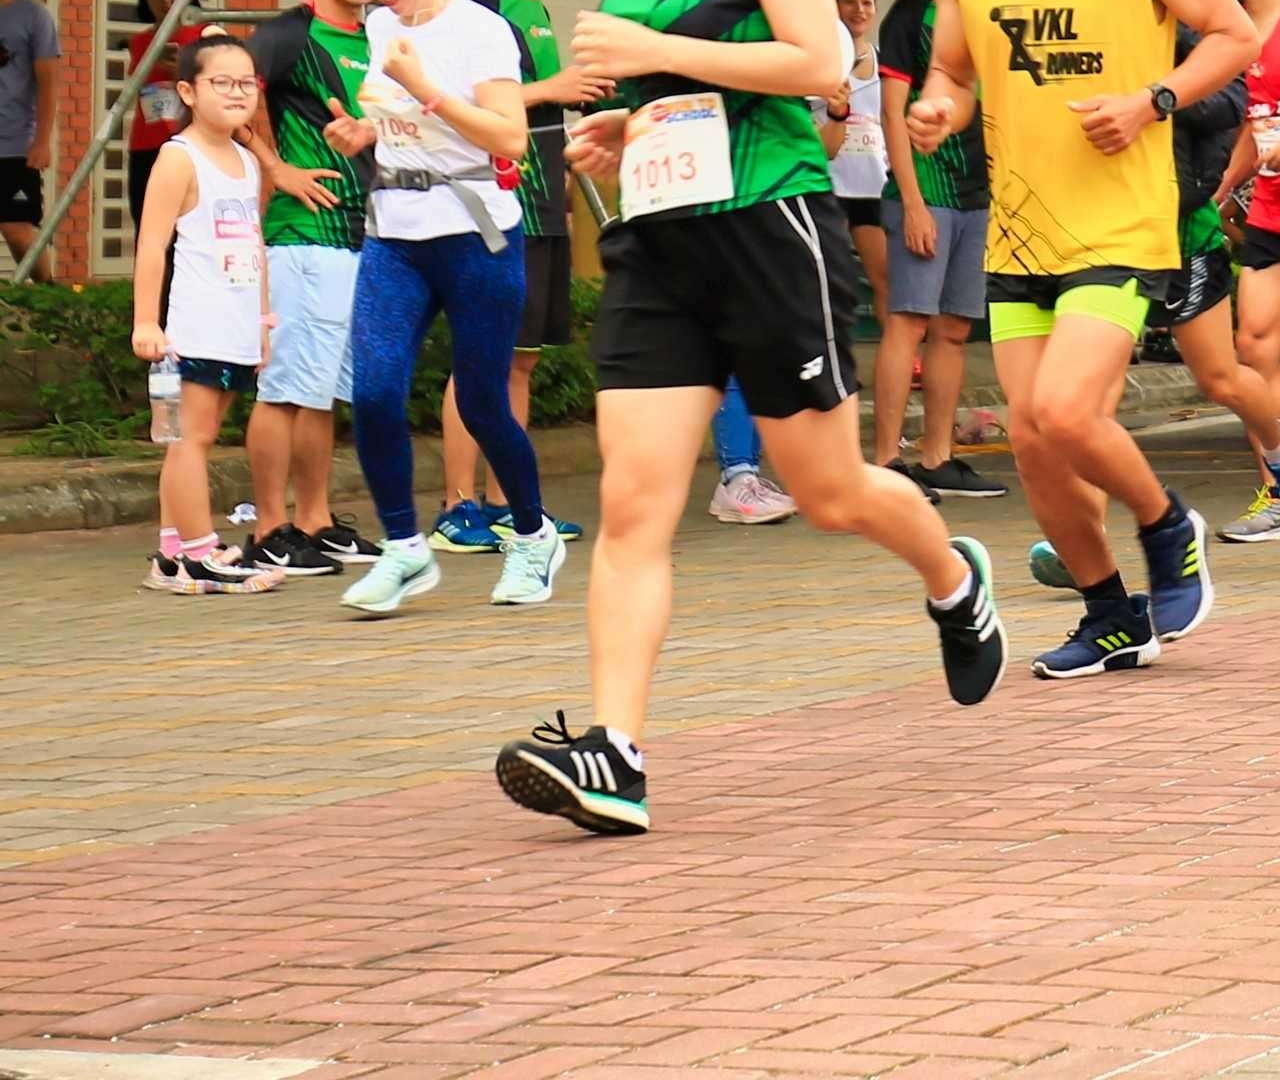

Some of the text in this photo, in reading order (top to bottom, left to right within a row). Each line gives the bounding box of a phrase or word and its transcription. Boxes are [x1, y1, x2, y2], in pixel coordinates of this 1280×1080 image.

[1032, 7, 1078, 42] VKL
[1045, 51, 1103, 75] RUNNERS
[632, 151, 697, 191] 1013
[223, 254, 235, 272] F
